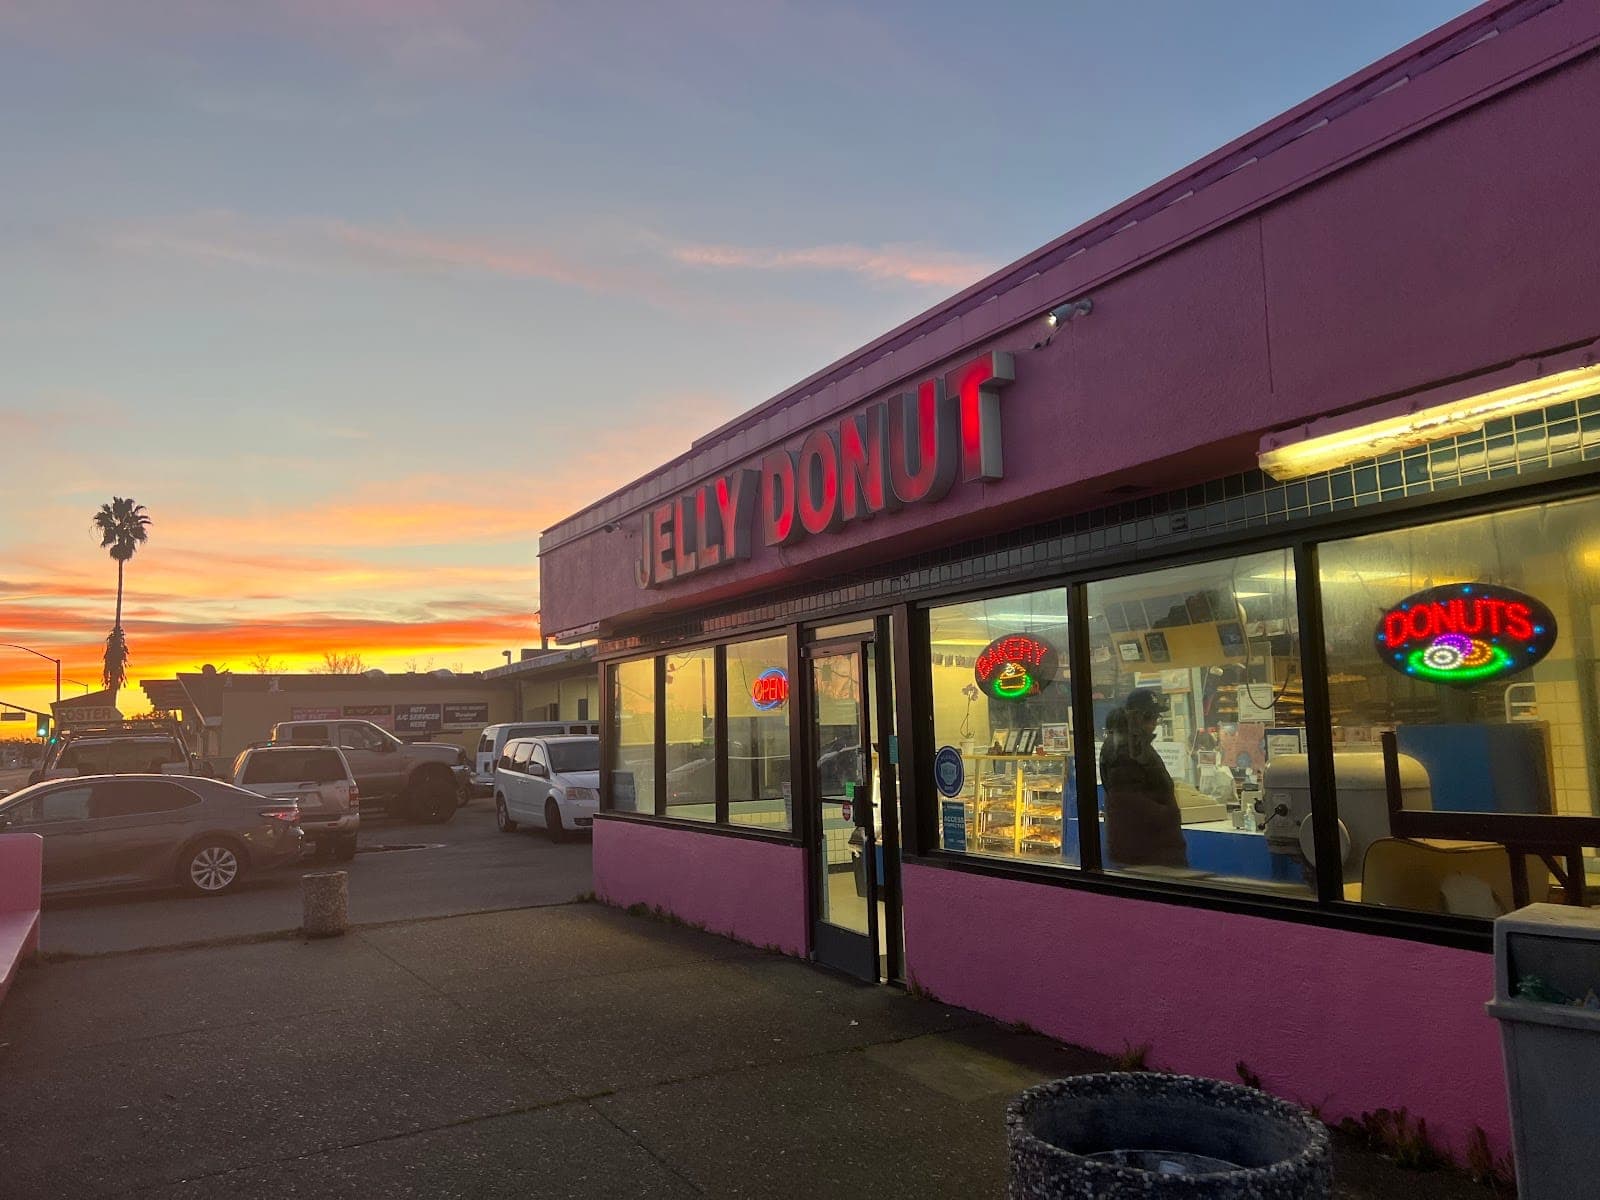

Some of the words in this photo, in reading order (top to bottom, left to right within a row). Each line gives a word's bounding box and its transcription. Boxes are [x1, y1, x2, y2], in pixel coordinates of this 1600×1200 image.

[634, 469, 758, 590] JELLY
[762, 351, 1013, 547] DONUT
[1385, 598, 1534, 648] DONUTS
[976, 636, 1048, 680] BAKERY
[752, 677, 787, 701] OPEN
